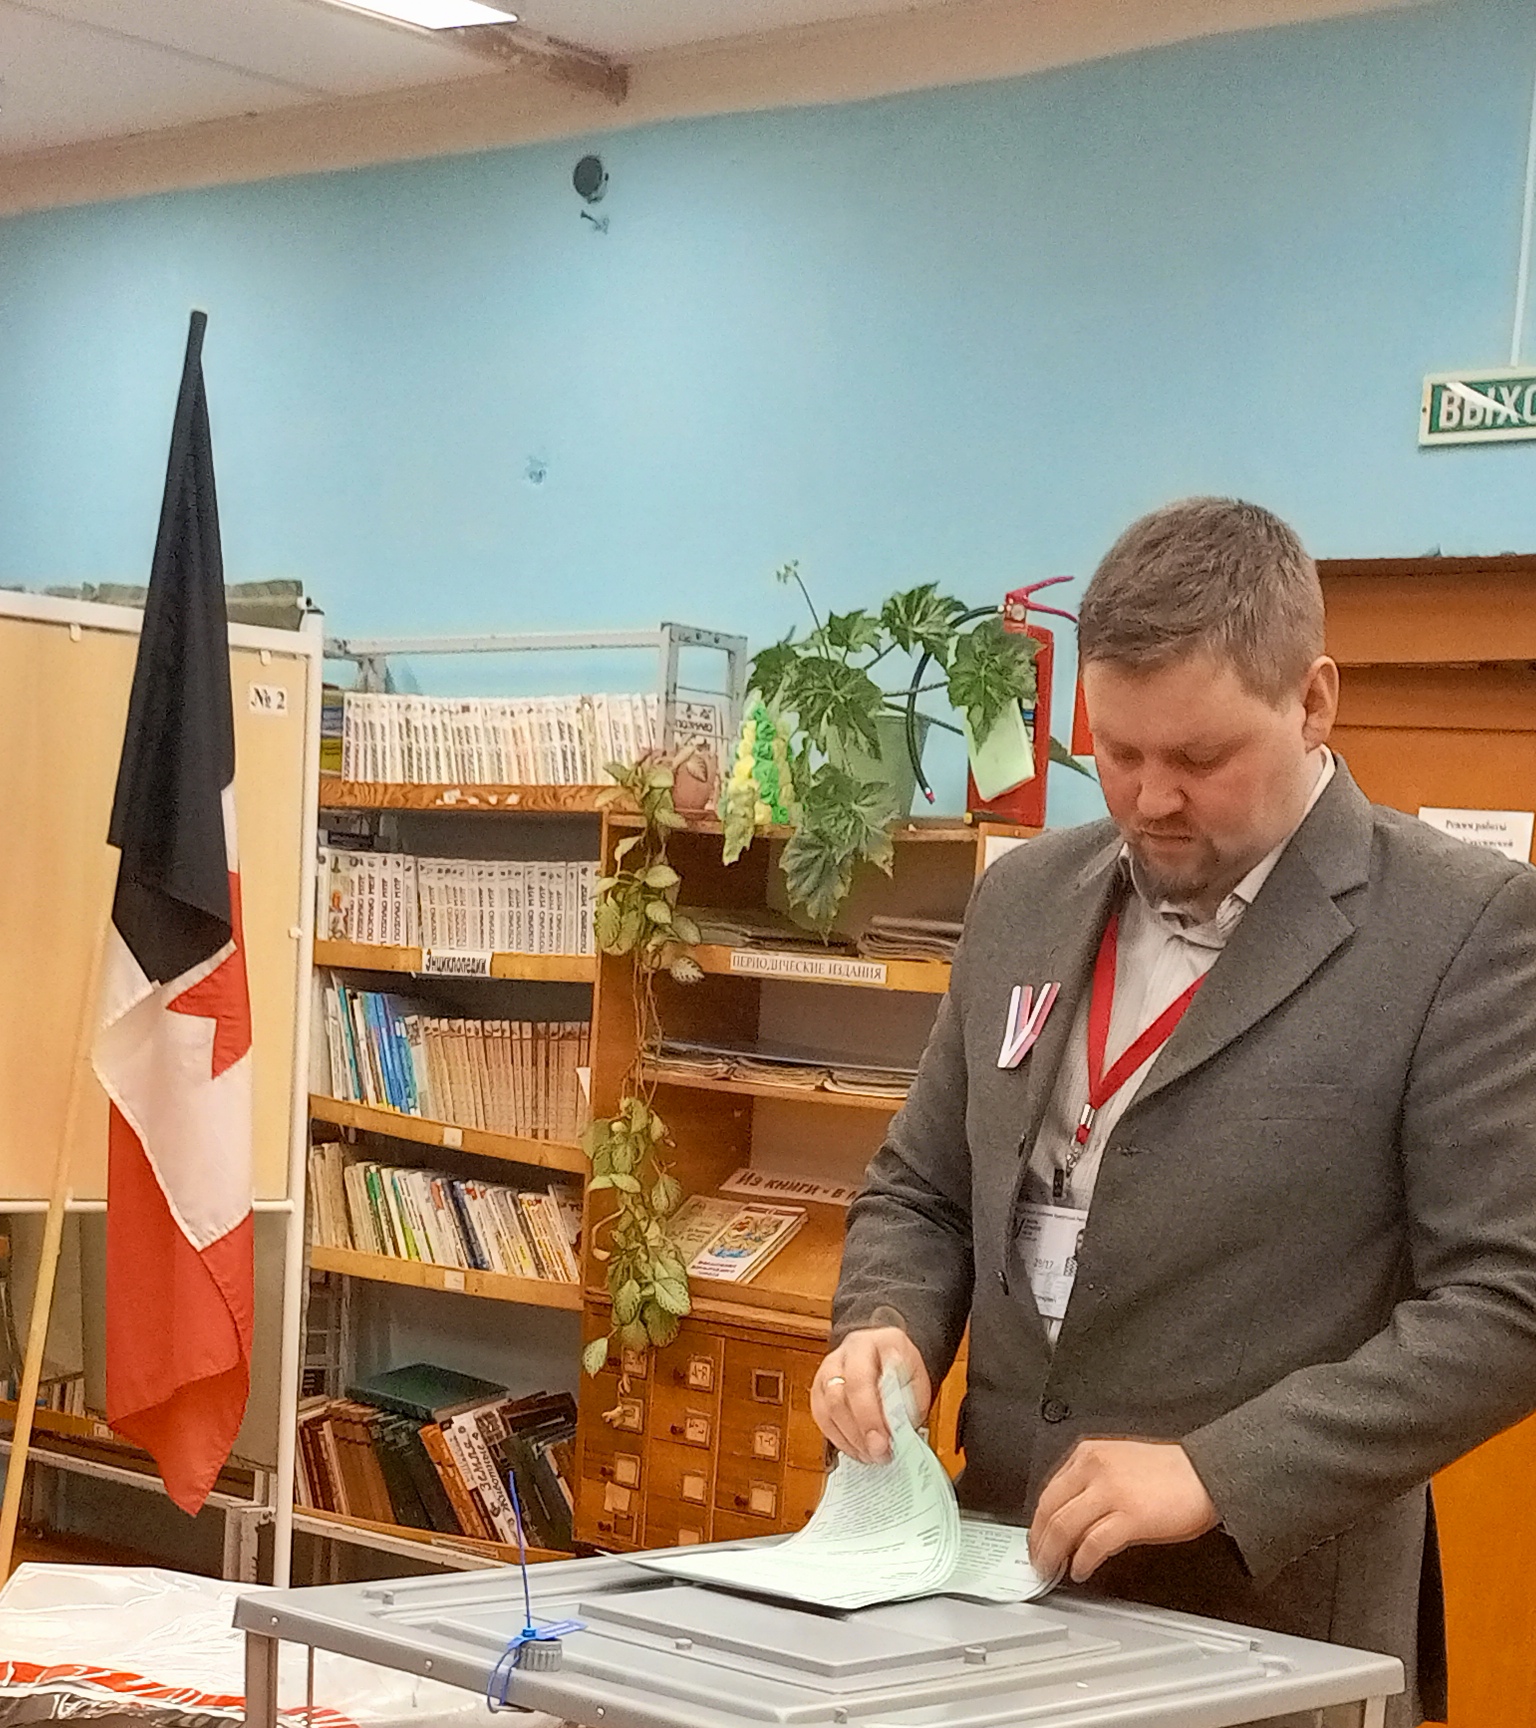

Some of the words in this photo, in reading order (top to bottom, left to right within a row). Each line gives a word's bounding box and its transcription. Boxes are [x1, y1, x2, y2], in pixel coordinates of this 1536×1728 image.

[250, 687, 272, 709] №
[276, 690, 286, 710] 2
[732, 954, 825, 975] ПЕРИОДИЧЕСКИЕ
[828, 963, 882, 980] ИЗДАНИЯ
